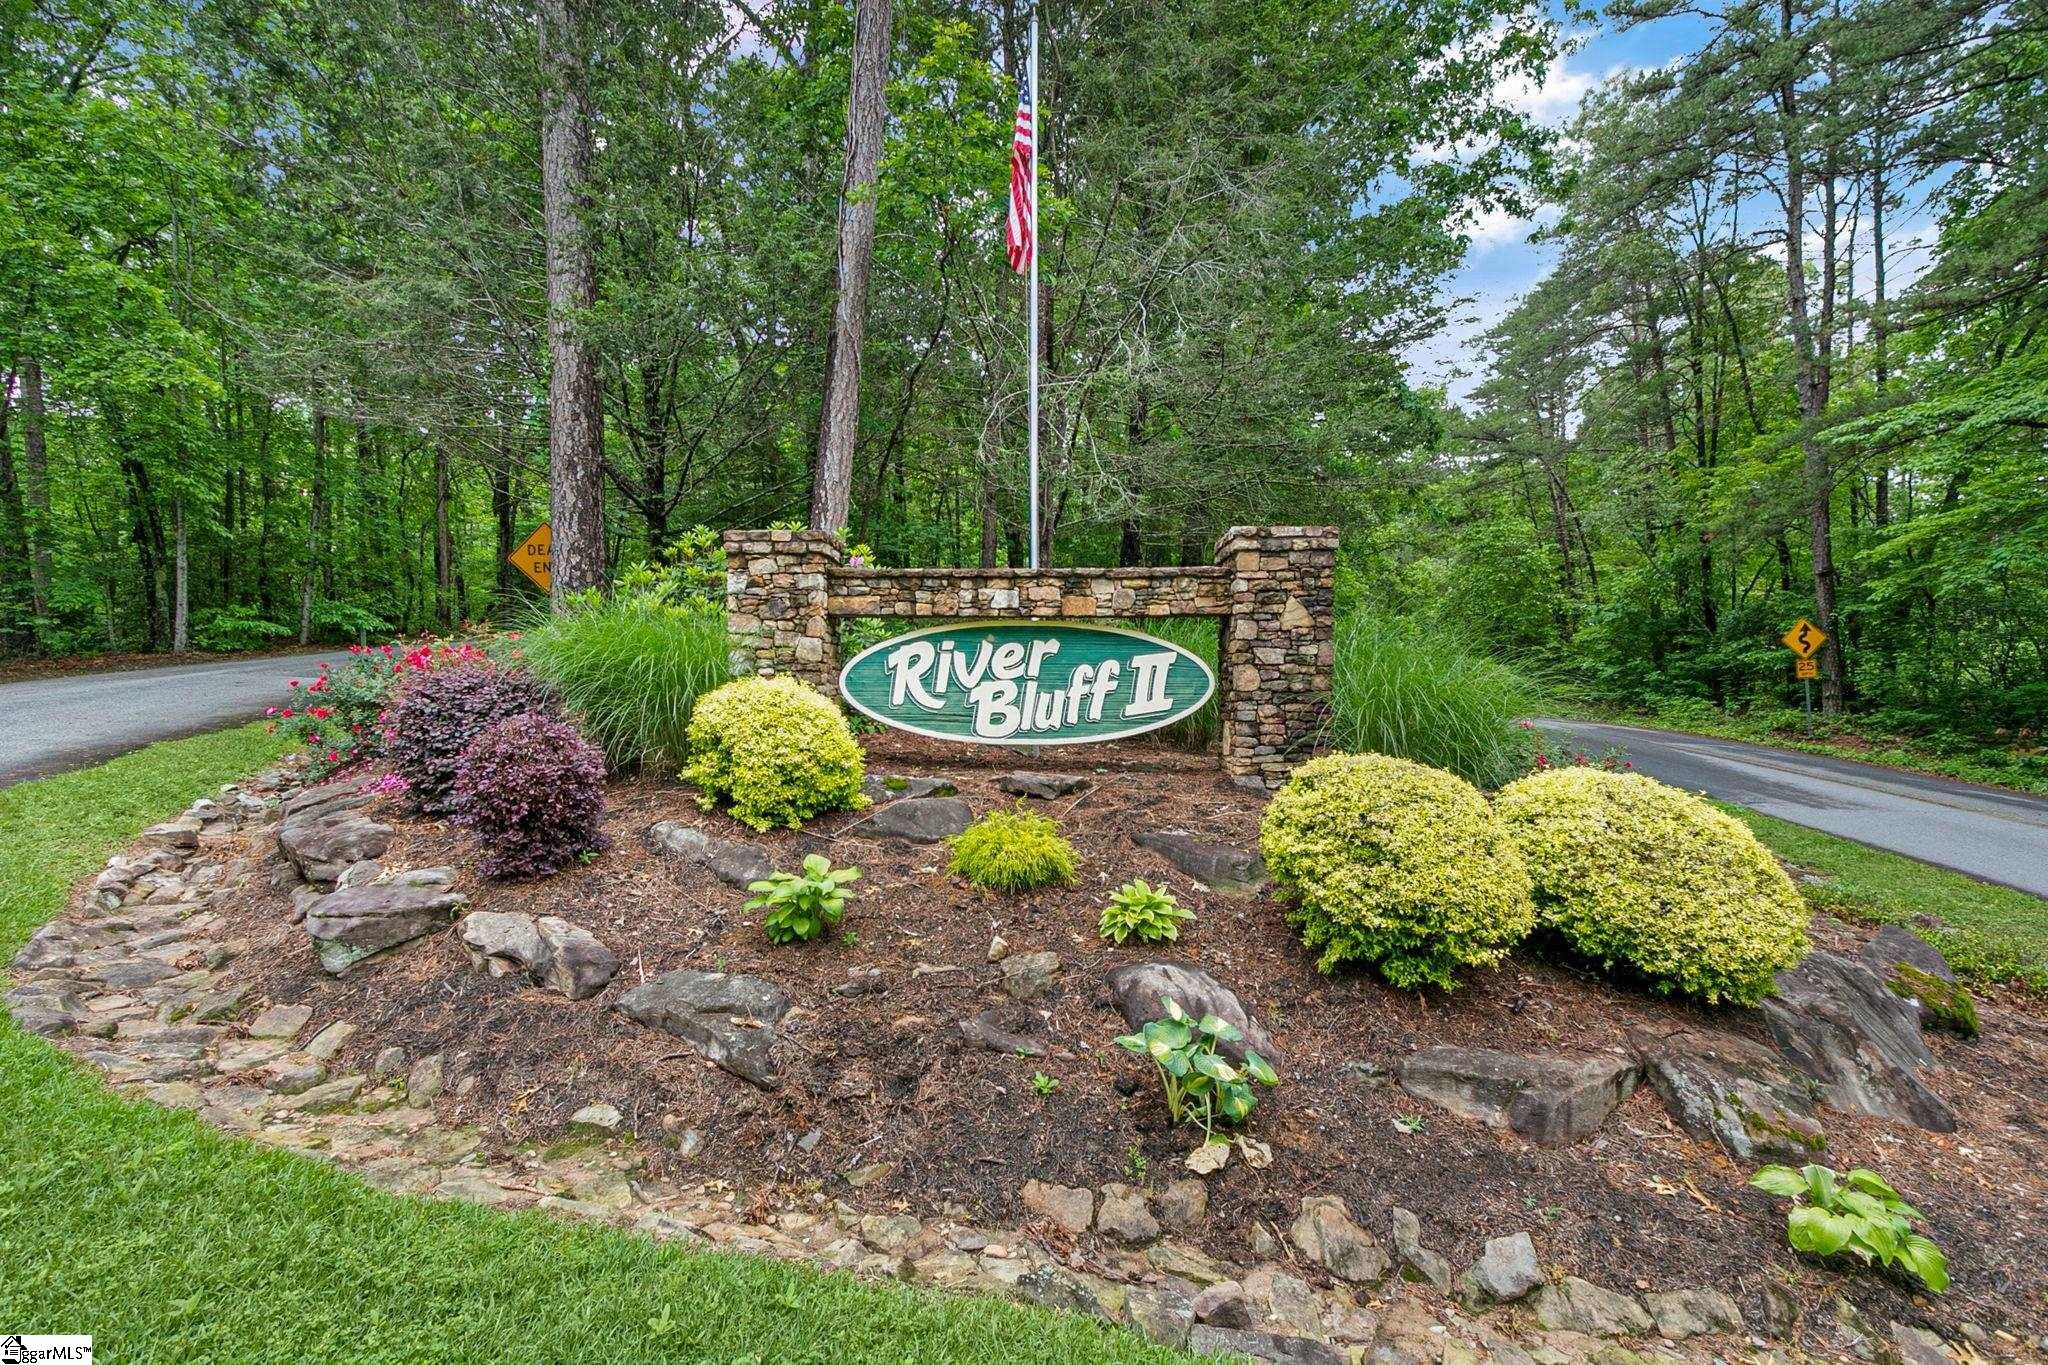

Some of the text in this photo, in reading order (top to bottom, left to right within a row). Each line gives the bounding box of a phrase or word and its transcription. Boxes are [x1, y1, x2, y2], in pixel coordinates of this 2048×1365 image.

[533, 562, 551, 573] EN
[885, 638, 1061, 710] River
[1798, 662, 1815, 671] 25
[966, 650, 1178, 738] Bluff II
